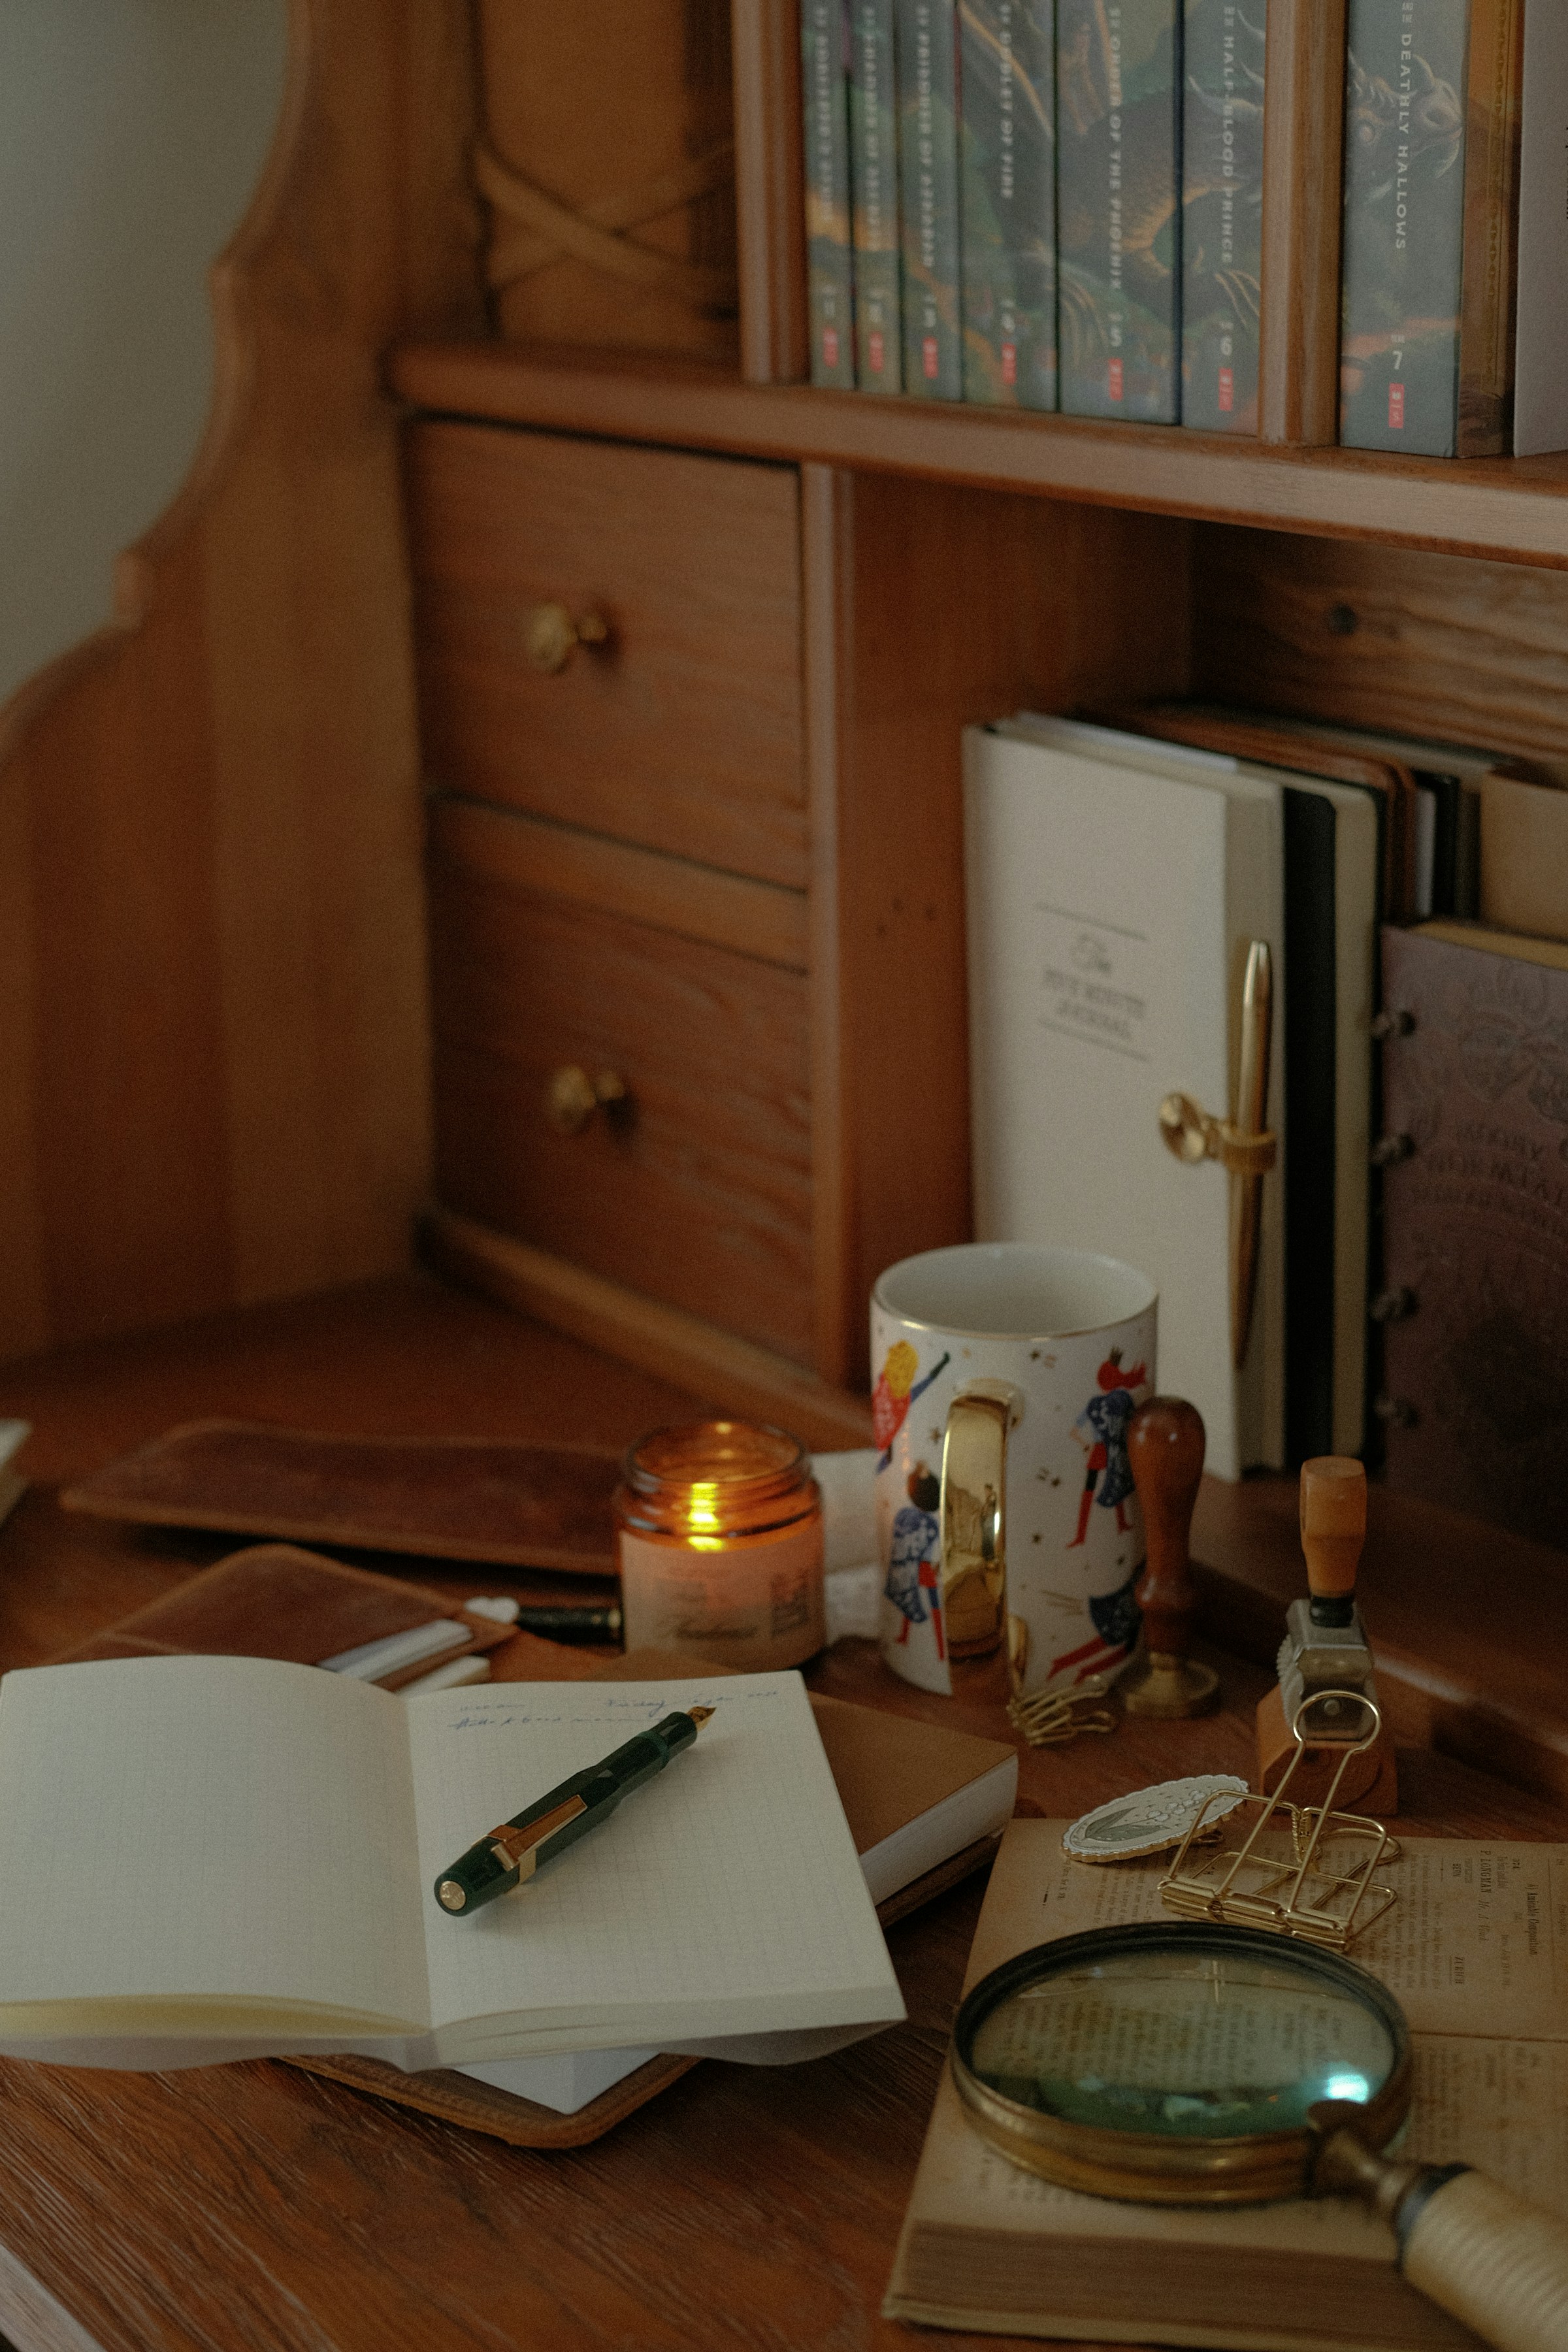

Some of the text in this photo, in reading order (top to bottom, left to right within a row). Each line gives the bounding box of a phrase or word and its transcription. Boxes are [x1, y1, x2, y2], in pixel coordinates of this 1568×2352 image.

[1108, 35, 1122, 107] ORDER
[1000, 118, 1014, 147] OF
[1109, 115, 1121, 142] OF
[1396, 34, 1412, 250] DEATHLY HALLOWS
[1221, 35, 1234, 263] HALF-BLOOD PRINCE
[1001, 153, 1014, 200] FIRE
[1109, 150, 1121, 190] THE
[1109, 199, 1122, 290] PHOENIX
[1110, 325, 1122, 347] 5
[1220, 335, 1233, 357] 6
[1393, 350, 1403, 370] 7
[1480, 1859, 1492, 1893] LONGMAN
